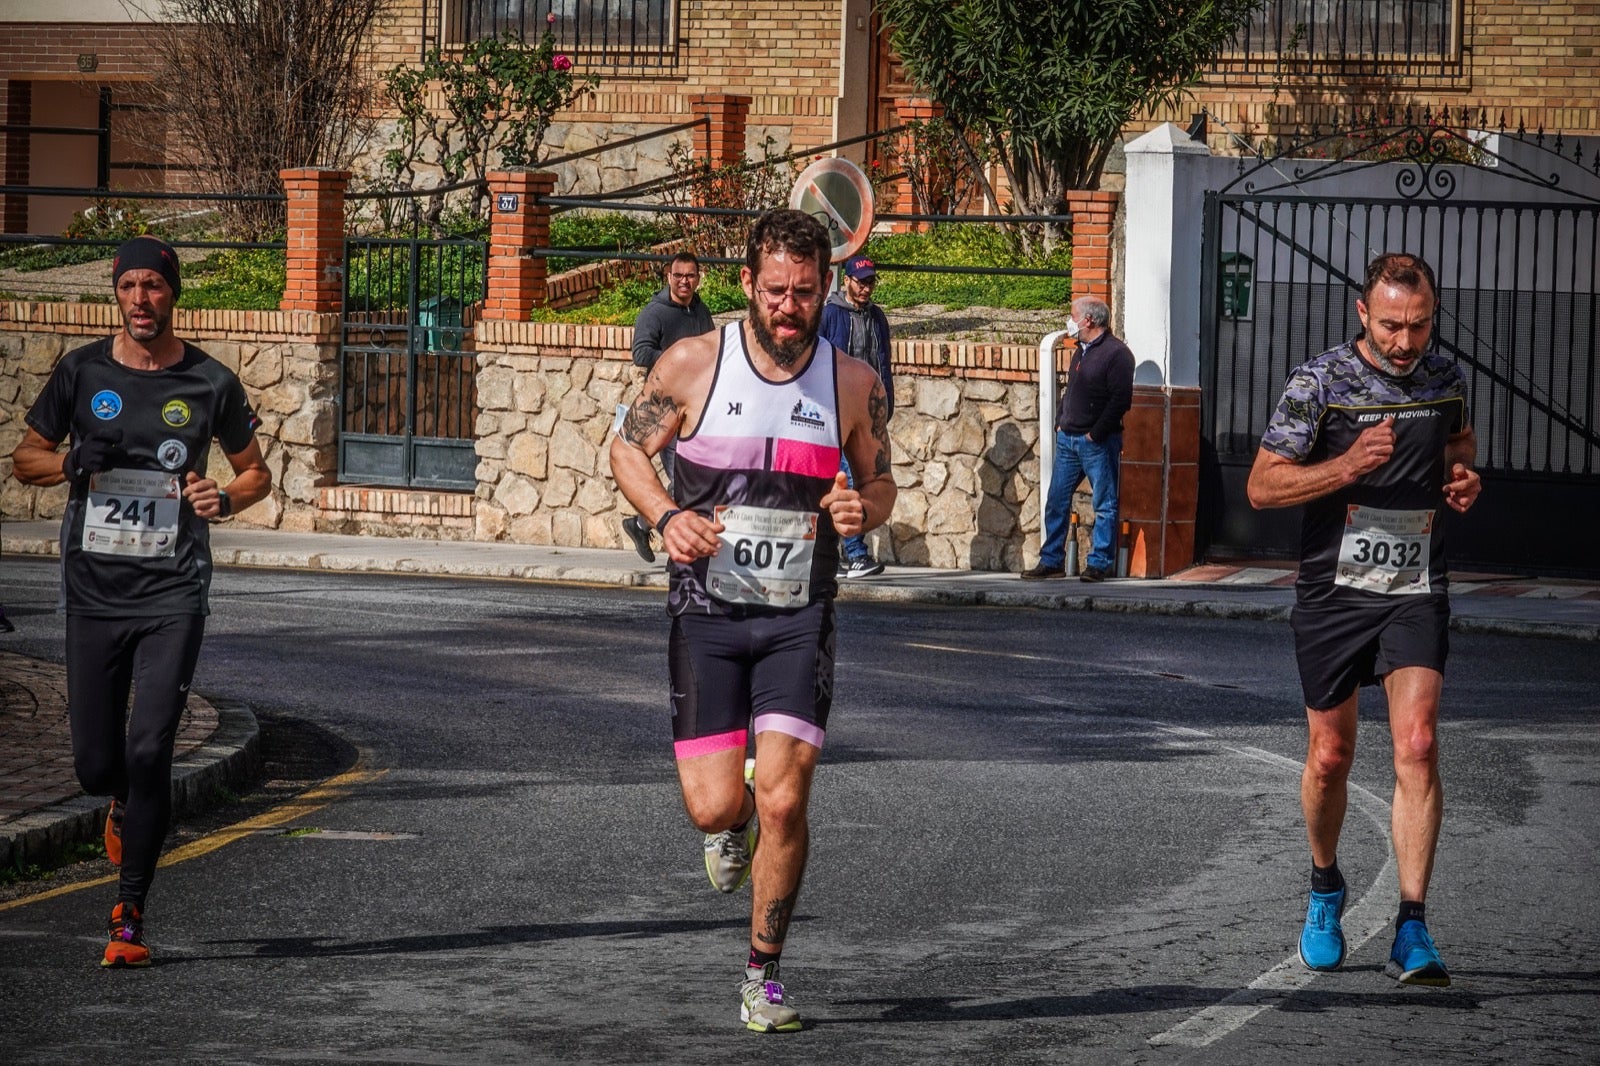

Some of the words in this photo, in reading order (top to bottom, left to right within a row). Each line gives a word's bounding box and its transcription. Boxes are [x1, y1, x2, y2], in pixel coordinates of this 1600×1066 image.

[501, 197, 514, 209] 37
[1357, 413, 1381, 422] KEEP
[1383, 412, 1396, 420] ON
[1398, 409, 1430, 420] MOVING
[104, 498, 156, 527] 241
[733, 538, 794, 570] 607
[1352, 538, 1422, 568] 3032
